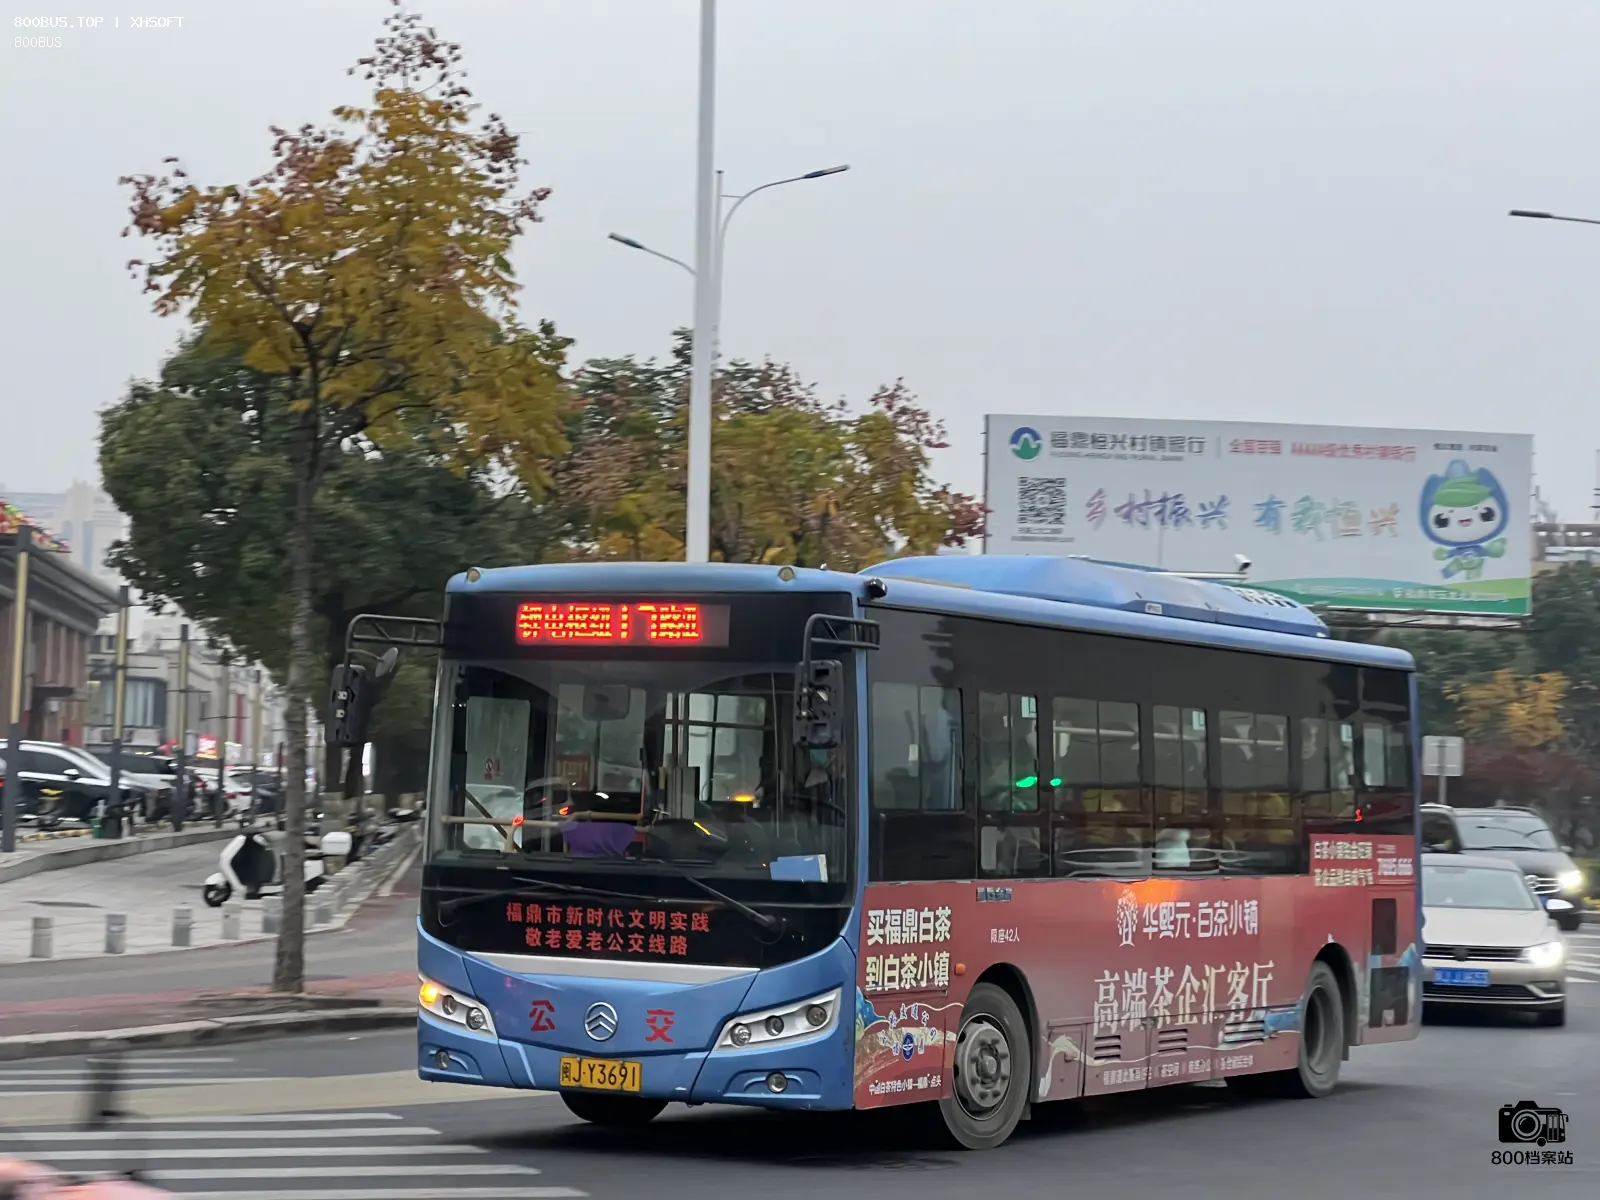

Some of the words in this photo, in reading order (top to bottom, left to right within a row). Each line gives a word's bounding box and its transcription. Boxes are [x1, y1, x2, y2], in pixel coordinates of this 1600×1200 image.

[506, 902, 710, 932] 福鼎市新时代文明实践
[867, 906, 952, 946] 买福鼎白茶
[525, 927, 688, 955] 敬老爱老公交线路
[865, 951, 951, 993] 到白茶小镇
[1093, 960, 1275, 1036] 高端茶企汇客厅
[529, 1000, 556, 1032] 公
[645, 1009, 675, 1043] 交
